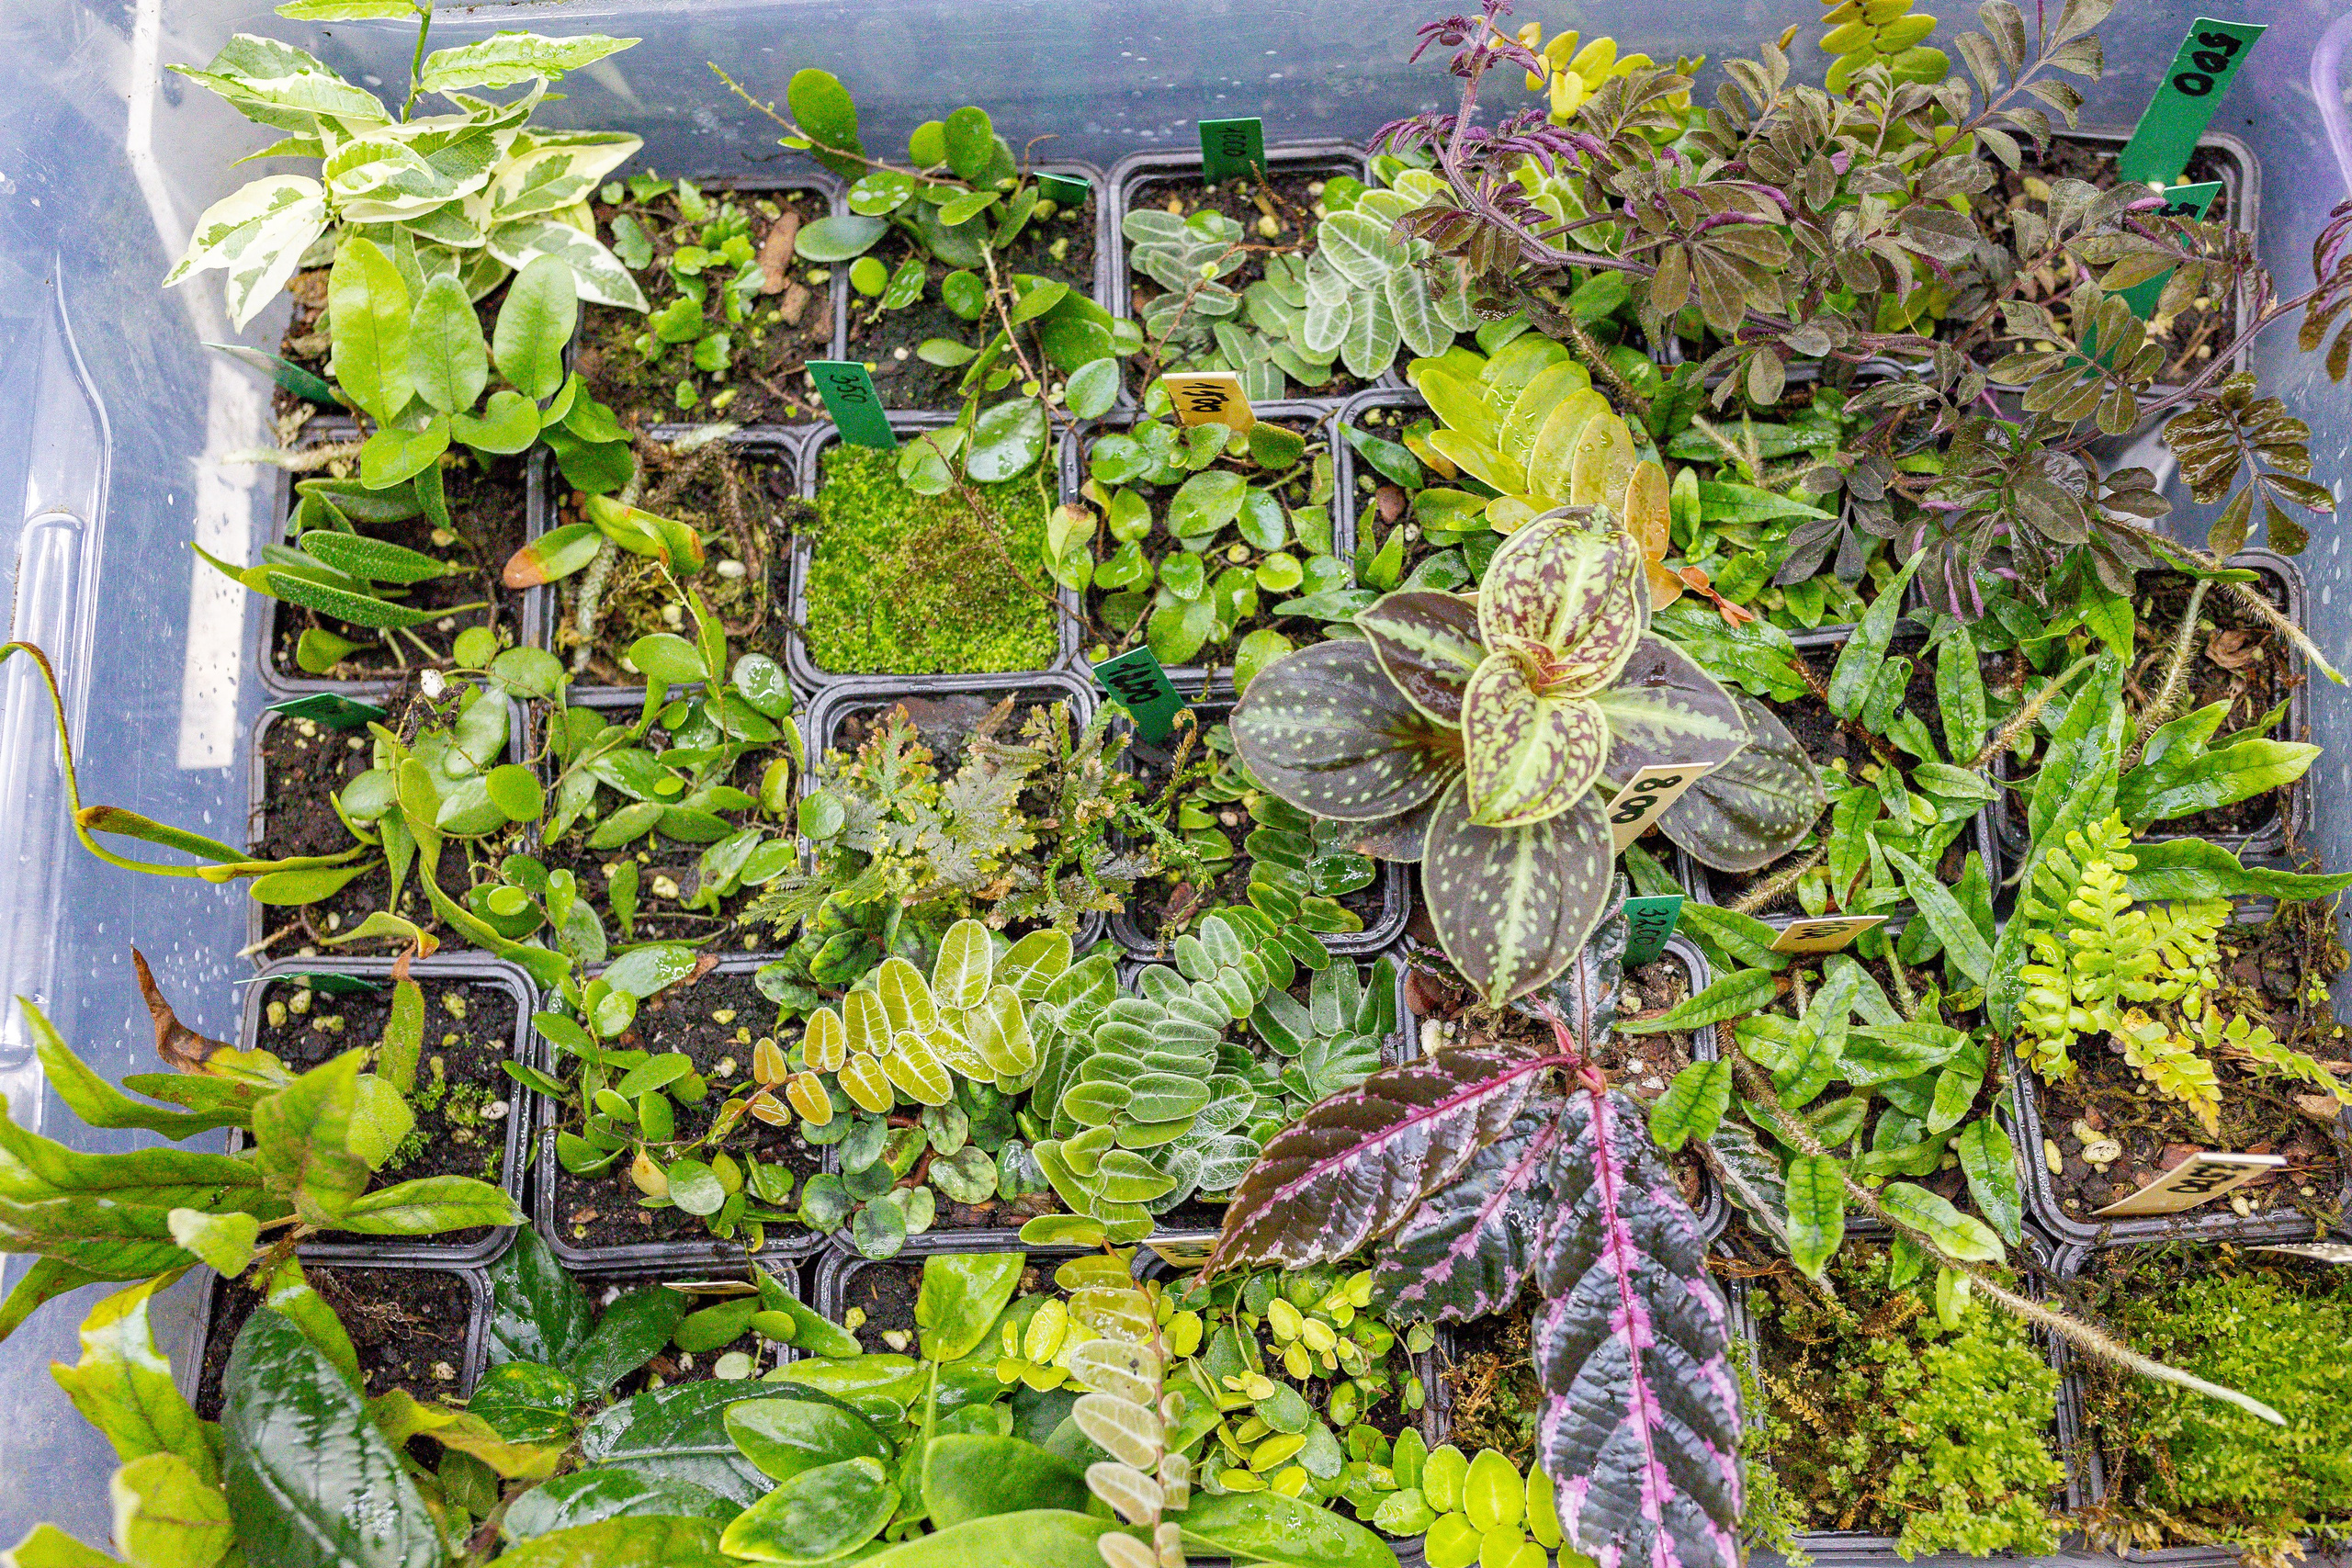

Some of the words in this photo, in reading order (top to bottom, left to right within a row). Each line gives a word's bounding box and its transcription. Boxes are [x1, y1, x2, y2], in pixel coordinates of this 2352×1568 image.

[2173, 32, 2243, 96] 500
[830, 374, 867, 403] 350
[1182, 382, 1229, 412] 1500
[1611, 774, 1683, 824] 800
